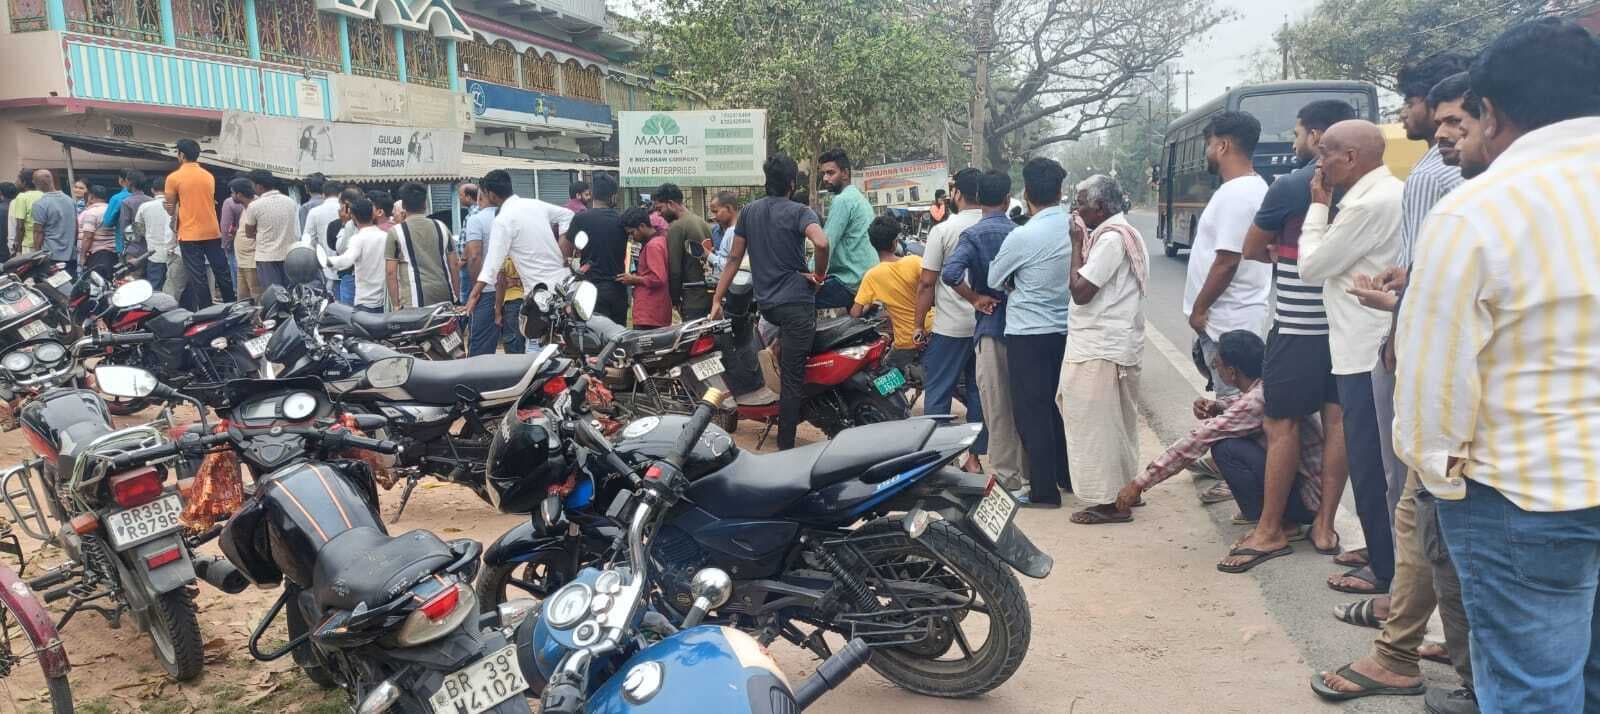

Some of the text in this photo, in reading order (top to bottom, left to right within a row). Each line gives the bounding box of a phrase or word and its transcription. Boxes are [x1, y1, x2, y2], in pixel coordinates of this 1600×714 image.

[378, 135, 402, 144] GULAB
[635, 136, 688, 146] MAYURI
[373, 147, 404, 156] MISTHAN
[371, 159, 404, 168] BHANDAR
[1272, 156, 1297, 165] EIC
[627, 166, 697, 175] ANANT ENTERPRISES
[120, 499, 174, 527] BR39A
[126, 512, 178, 540] R9796
[445, 655, 510, 699] BR 39
